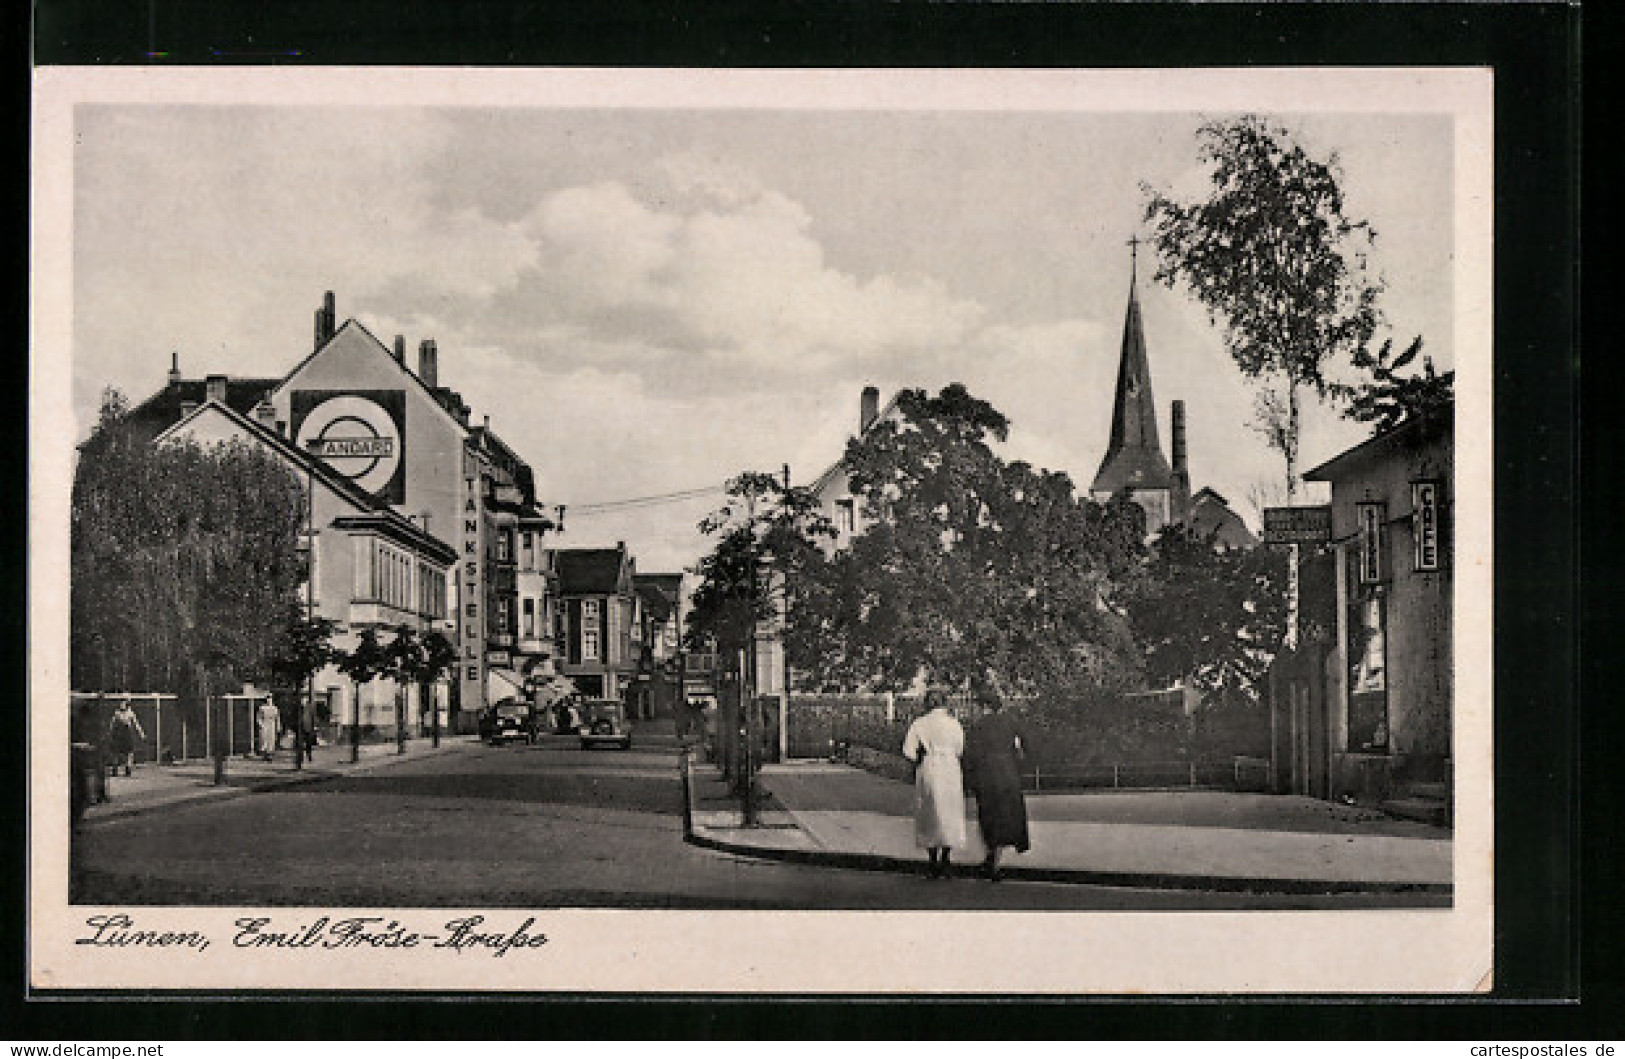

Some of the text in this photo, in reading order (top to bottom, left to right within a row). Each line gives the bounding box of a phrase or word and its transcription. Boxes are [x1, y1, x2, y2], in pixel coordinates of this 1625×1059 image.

[465, 478, 477, 680] TANKSTELLE
[76, 914, 210, 953] Lünen,
[233, 916, 330, 948] Emil
